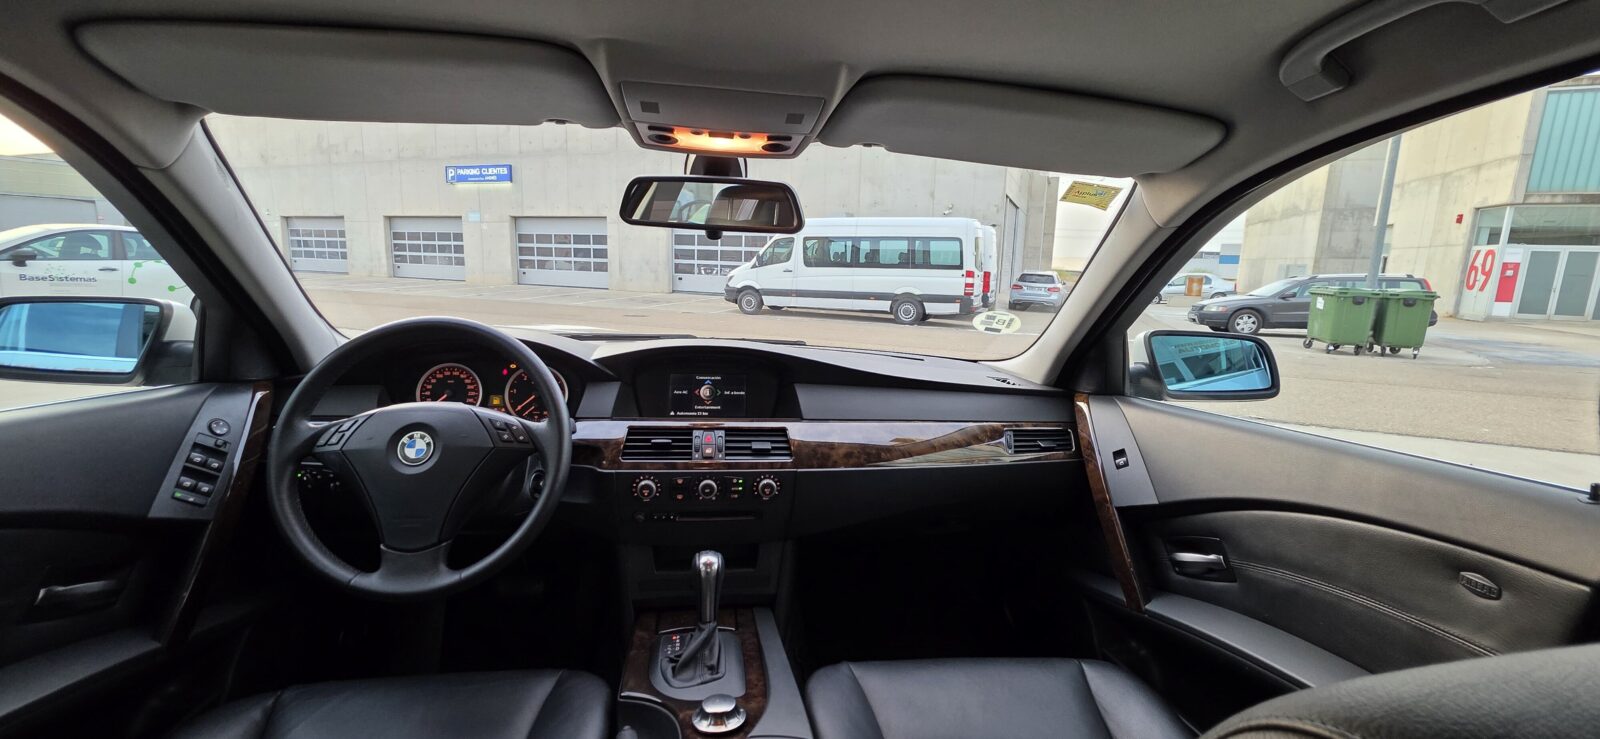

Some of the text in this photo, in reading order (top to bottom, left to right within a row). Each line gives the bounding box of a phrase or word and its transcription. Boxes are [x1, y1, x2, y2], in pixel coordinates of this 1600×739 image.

[448, 169, 455, 180] P
[481, 167, 508, 175] CLIENTES
[1465, 249, 1496, 292] 69
[19, 273, 97, 283] BaseSistemas
[403, 433, 431, 444] BMW
